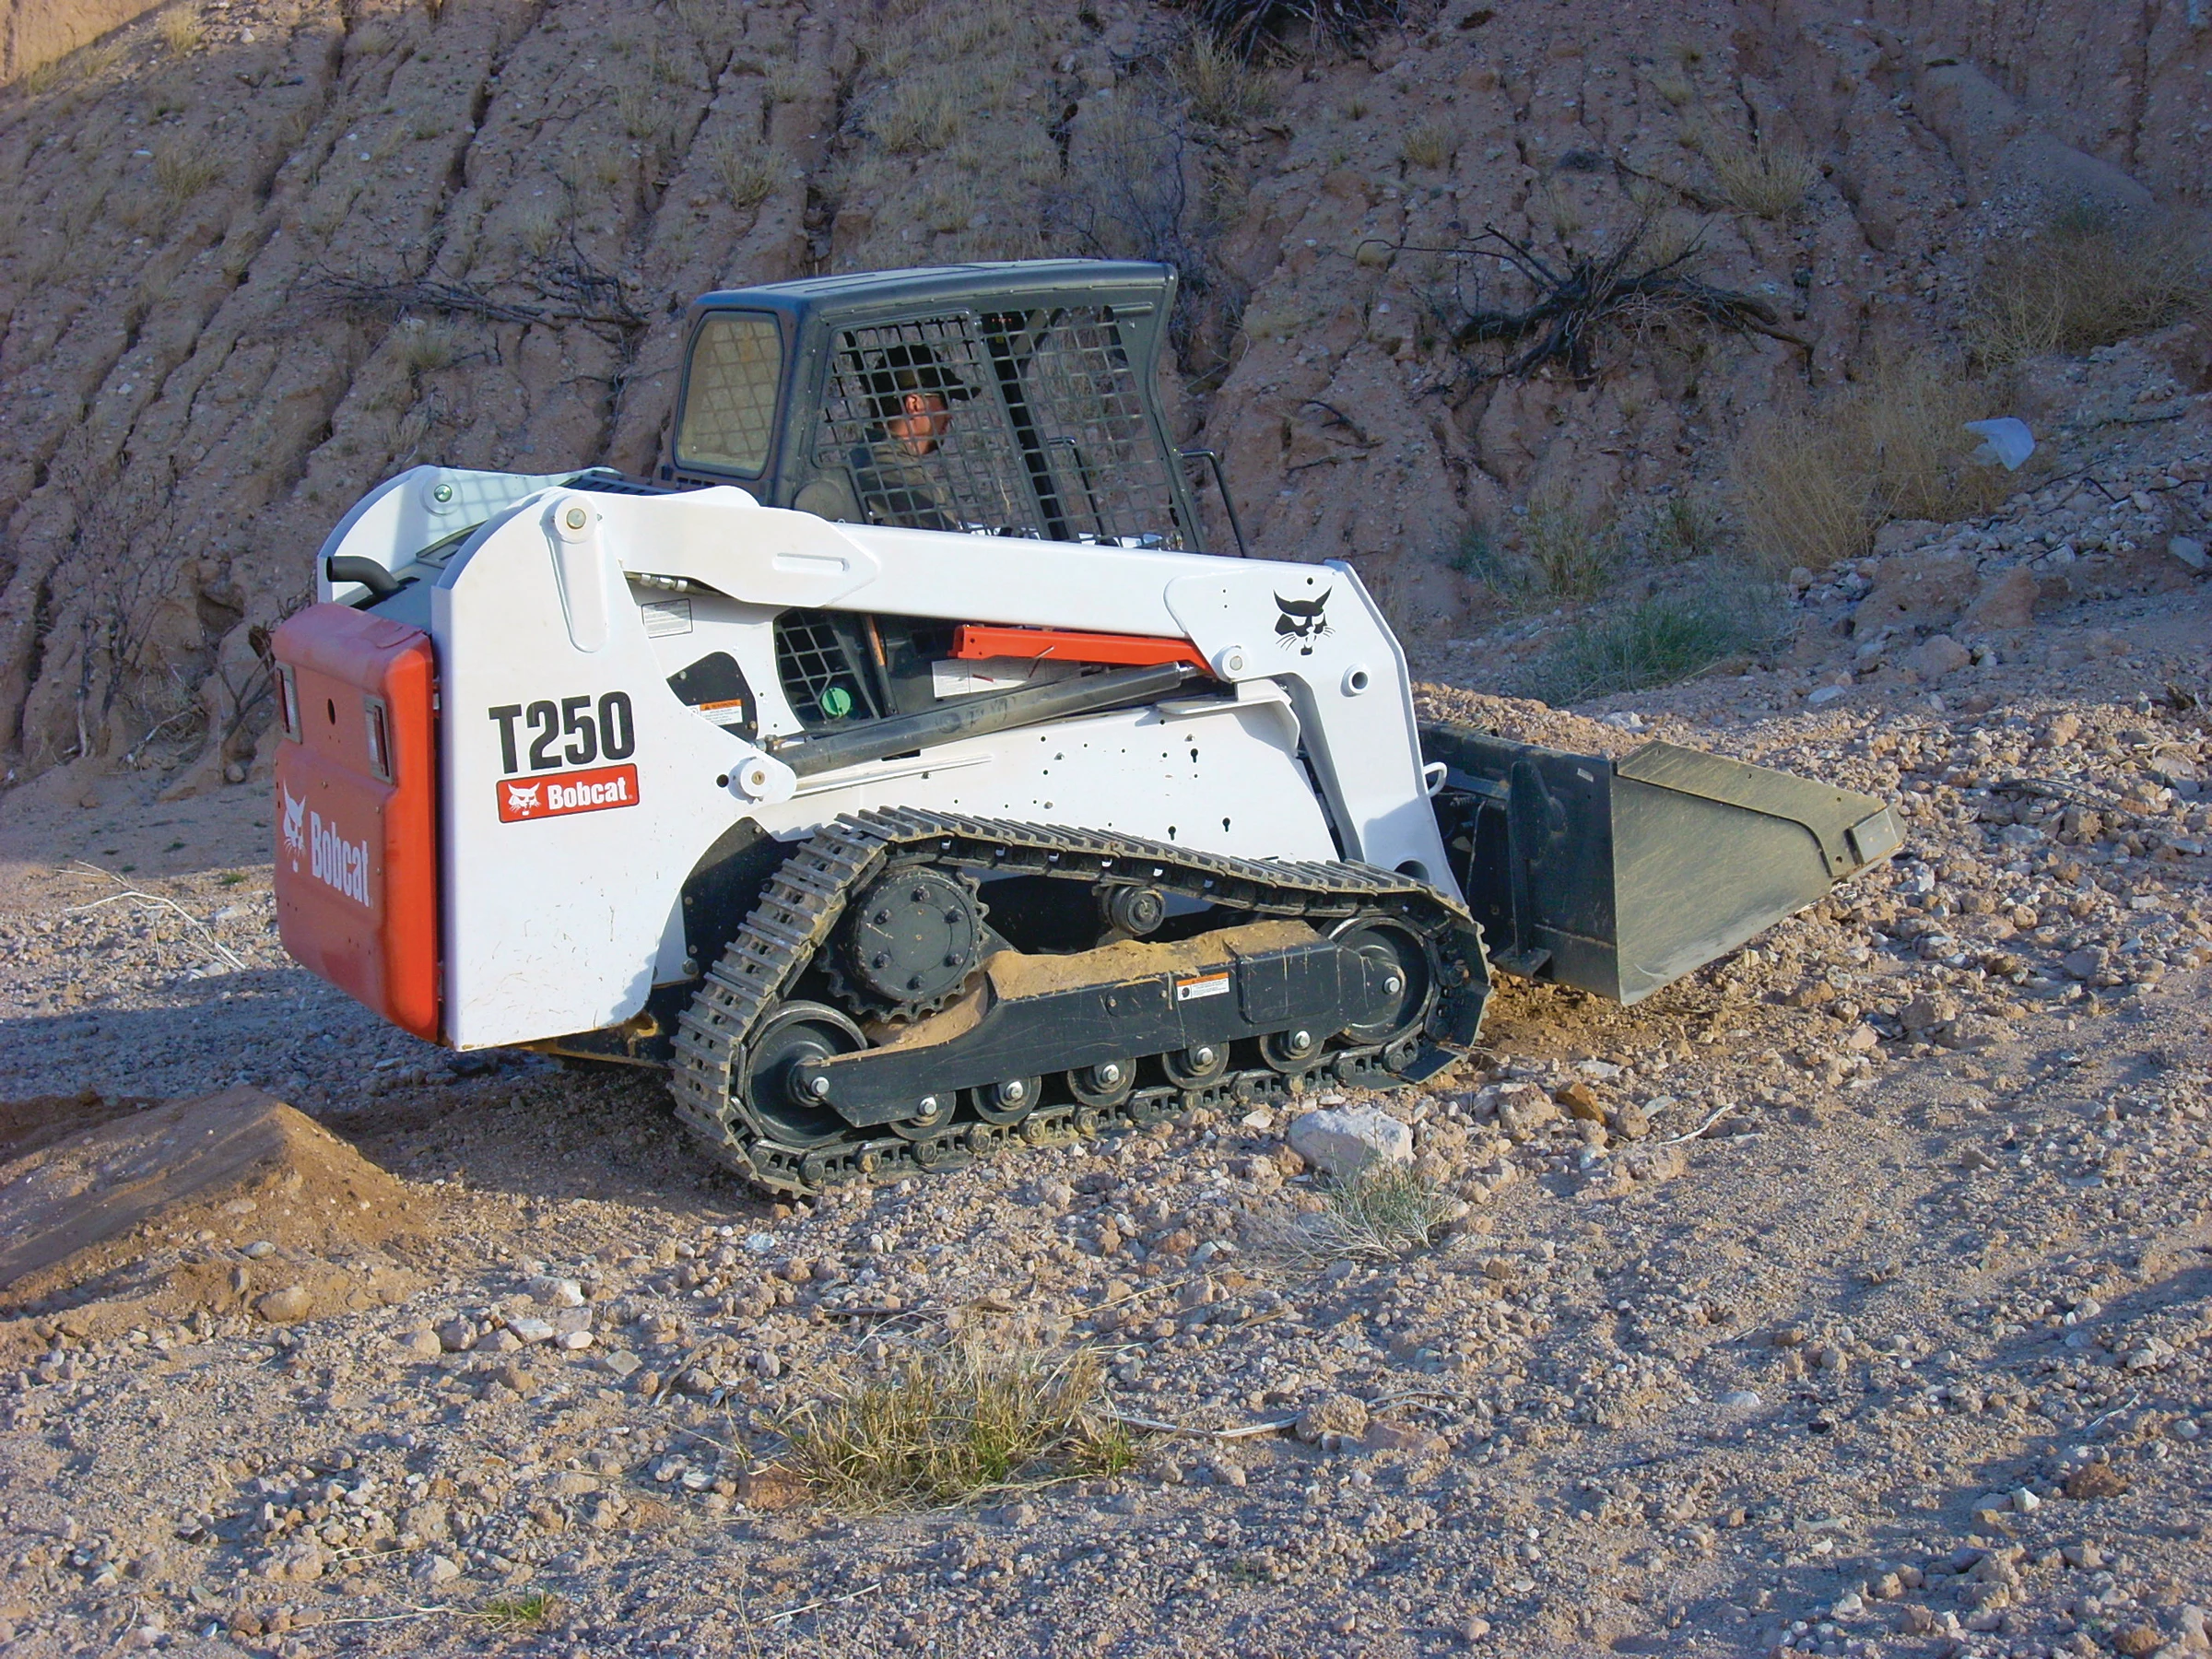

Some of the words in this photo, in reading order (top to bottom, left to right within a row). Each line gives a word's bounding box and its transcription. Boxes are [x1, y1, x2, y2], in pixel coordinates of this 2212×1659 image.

[488, 691, 635, 773] T250
[547, 777, 627, 809] Bobcat
[312, 811, 369, 907] Bobcat
